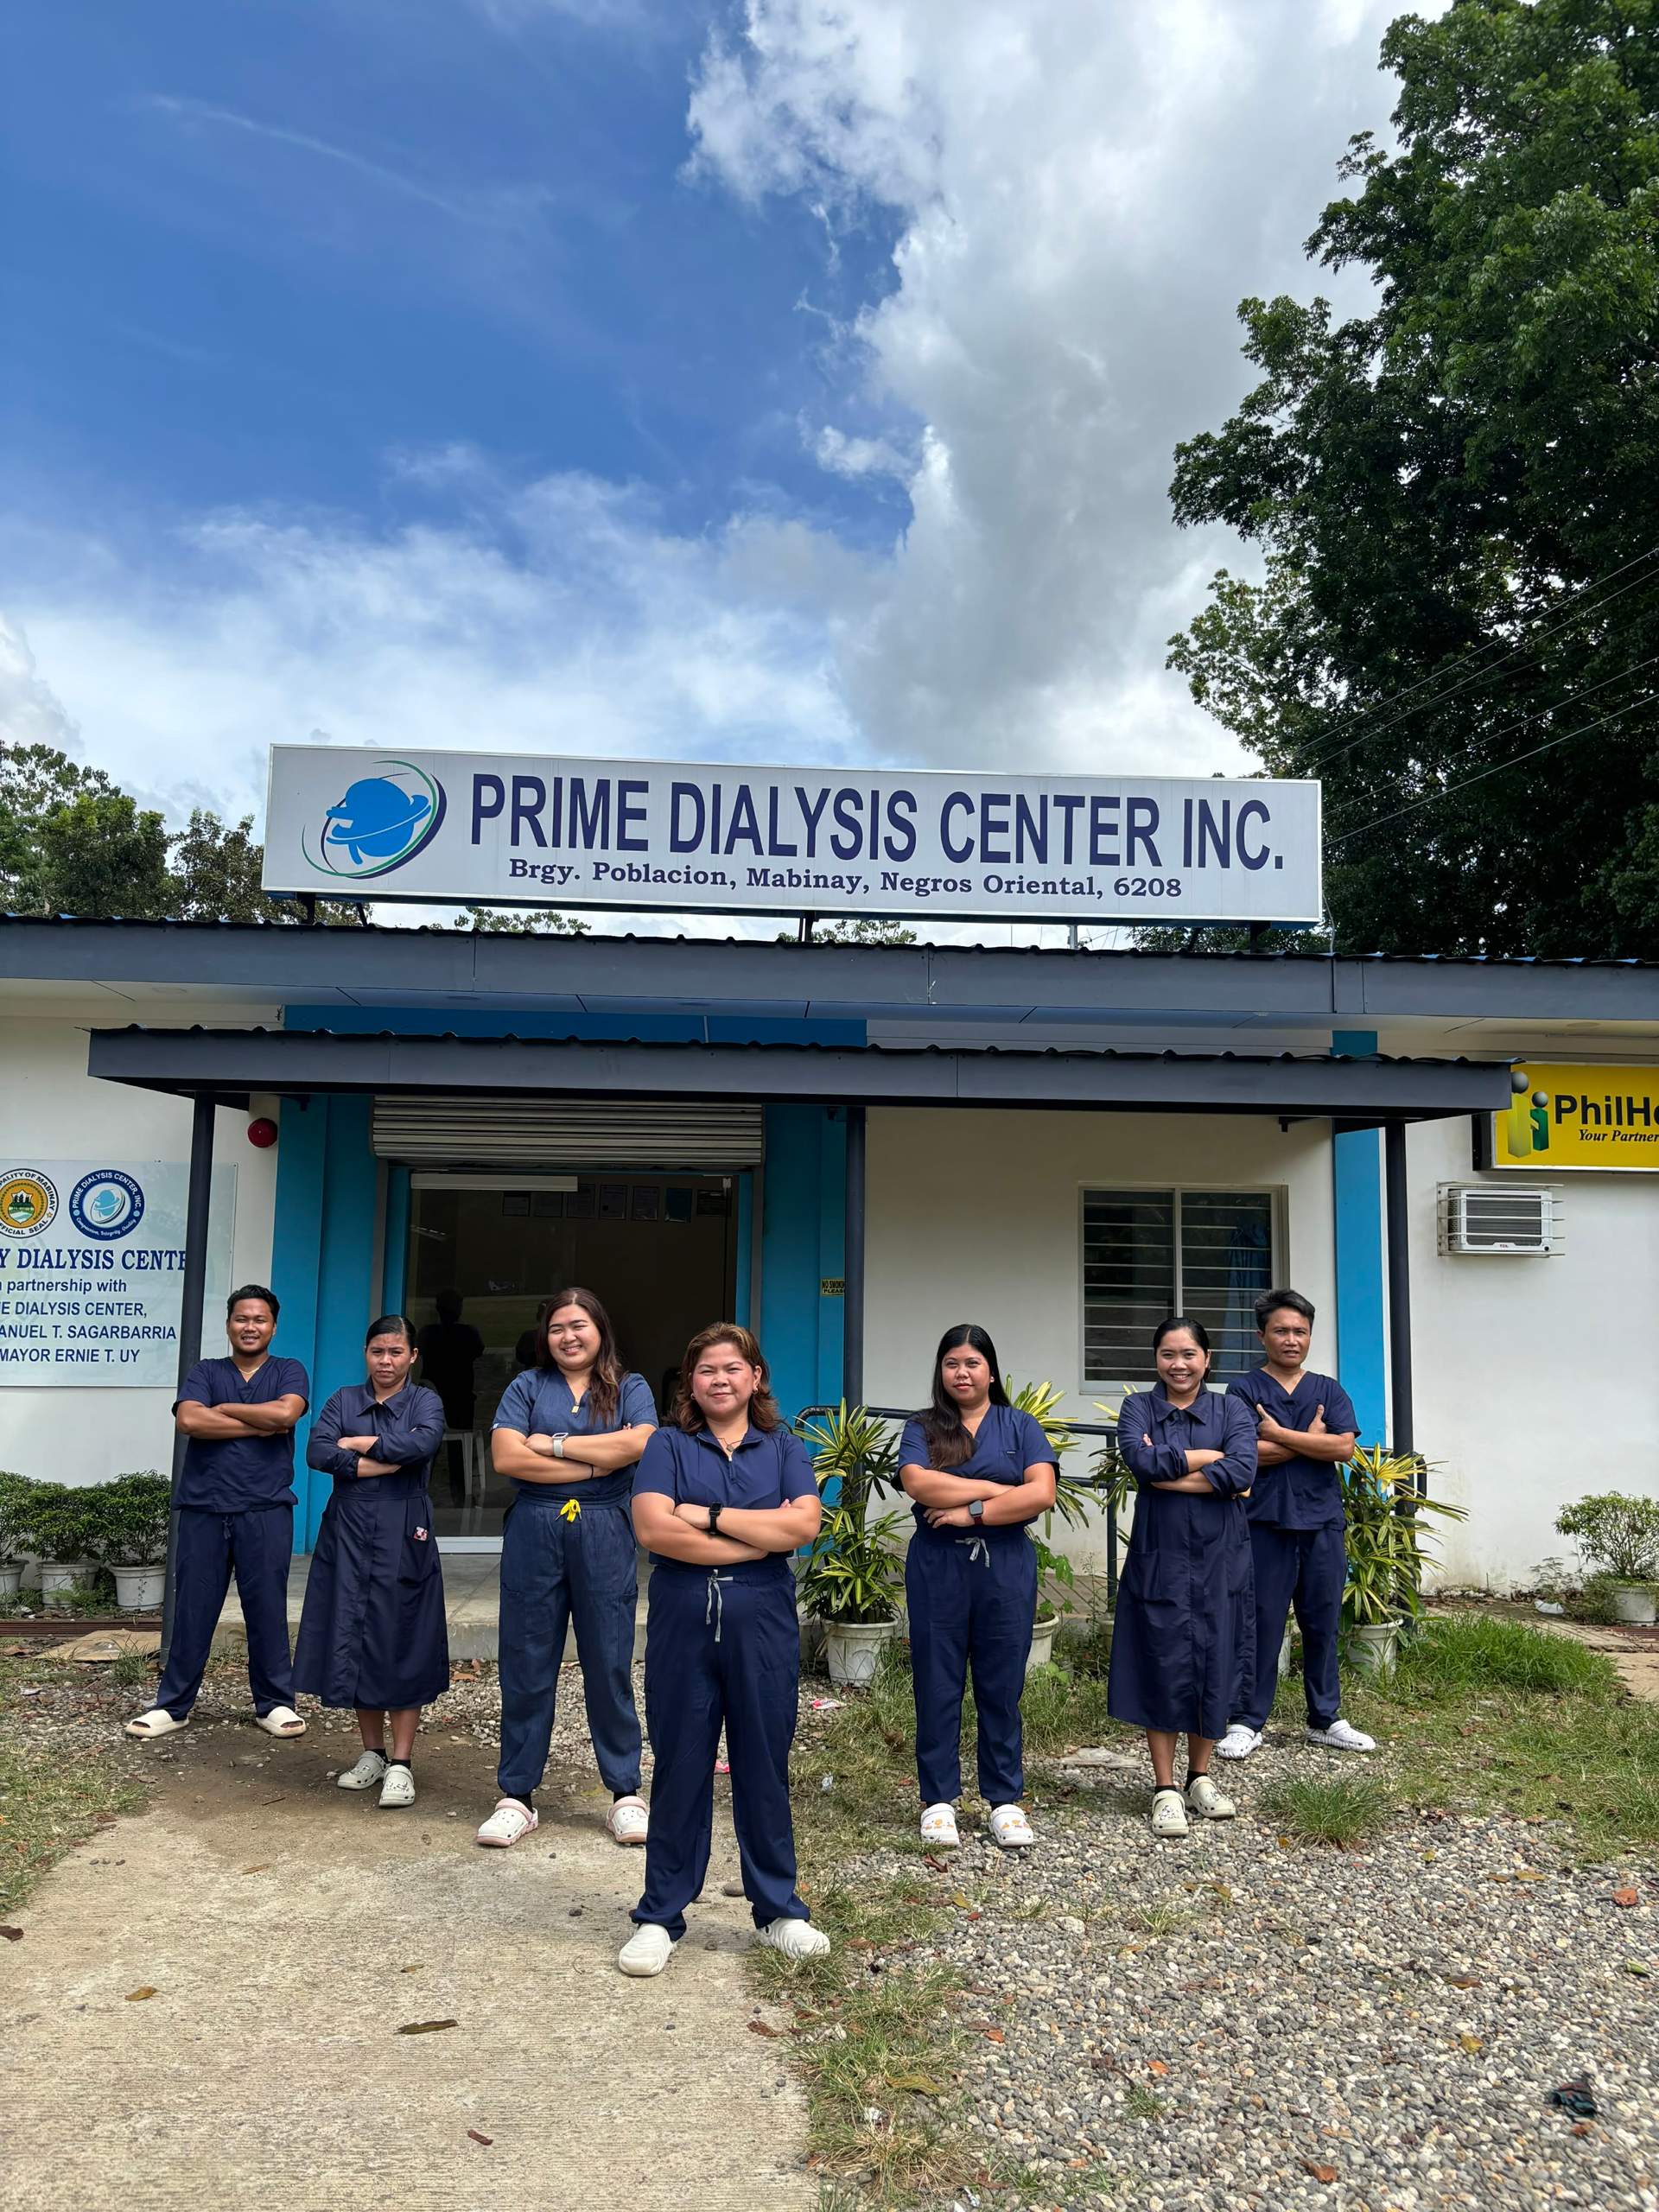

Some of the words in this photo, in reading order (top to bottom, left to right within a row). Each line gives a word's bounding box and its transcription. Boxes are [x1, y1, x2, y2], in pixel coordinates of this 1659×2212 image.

[471, 773, 649, 852] PRIME
[670, 782, 918, 862] DIALYSIS
[940, 791, 1162, 868] CENTER
[1183, 799, 1283, 871] INC.
[509, 858, 581, 886] Brgy.
[593, 861, 736, 890] Poblacion,
[746, 868, 870, 895] Mabinay,
[880, 872, 973, 898] Negros
[983, 874, 1103, 899] Oriental,
[1114, 877, 1182, 898] 6208
[1579, 1129, 1608, 1141] Your
[1611, 1130, 1659, 1142] Partner
[72, 1186, 84, 1209] PRIME
[80, 1172, 113, 1189] DIALYSIS
[29, 1219, 48, 1234] SEAL
[16, 1249, 114, 1269] DIALYSIS
[7, 1279, 92, 1294] partnership
[97, 1279, 127, 1292] with
[15, 1301, 80, 1315] DIALYSIS
[85, 1302, 147, 1319] CENTER,
[52, 1325, 63, 1338] T.
[67, 1325, 177, 1339] SAGARBARRIA
[0, 1348, 50, 1362] MAYOR
[55, 1349, 99, 1363] ERNIE
[105, 1349, 115, 1363] T.
[120, 1349, 140, 1363] UY
